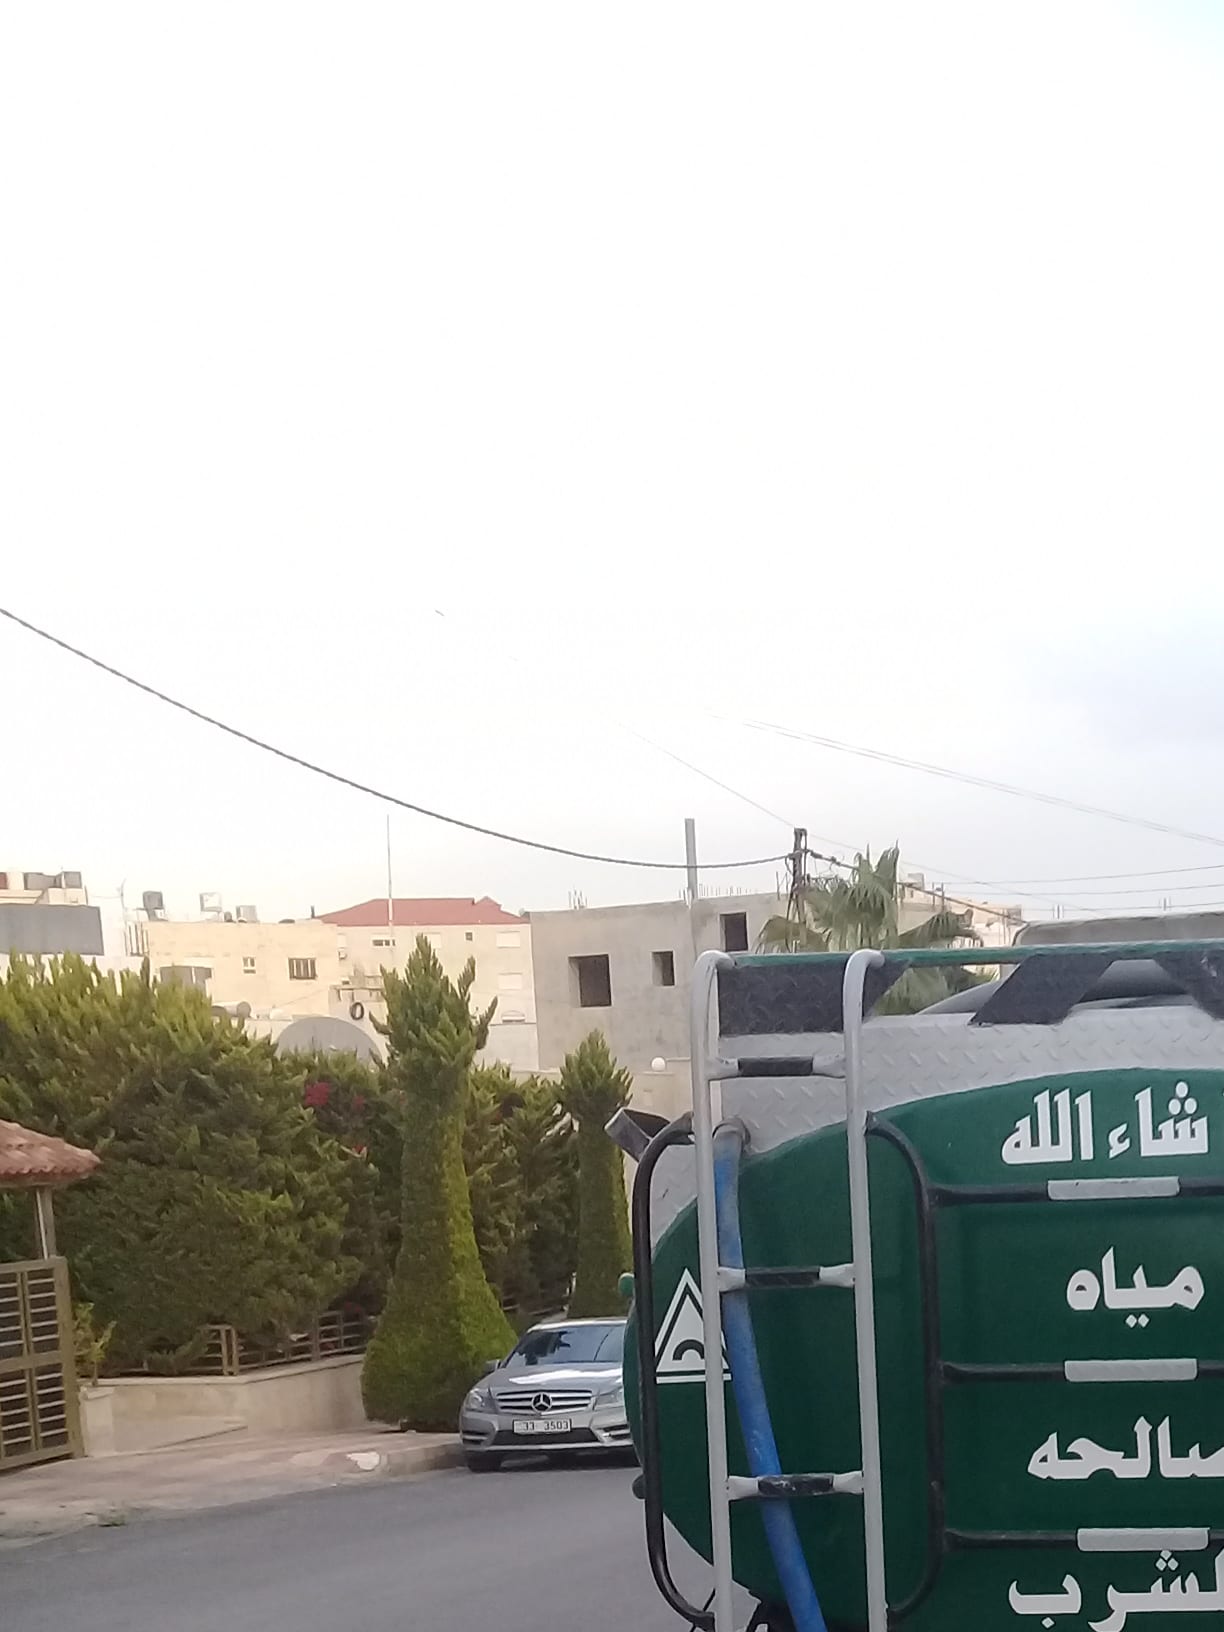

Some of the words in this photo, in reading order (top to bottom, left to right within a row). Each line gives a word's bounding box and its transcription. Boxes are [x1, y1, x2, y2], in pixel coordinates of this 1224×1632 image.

[1001, 1087, 1094, 1165] الله
[1108, 1081, 1209, 1159] شاء
[1066, 1246, 1205, 1328] مياه
